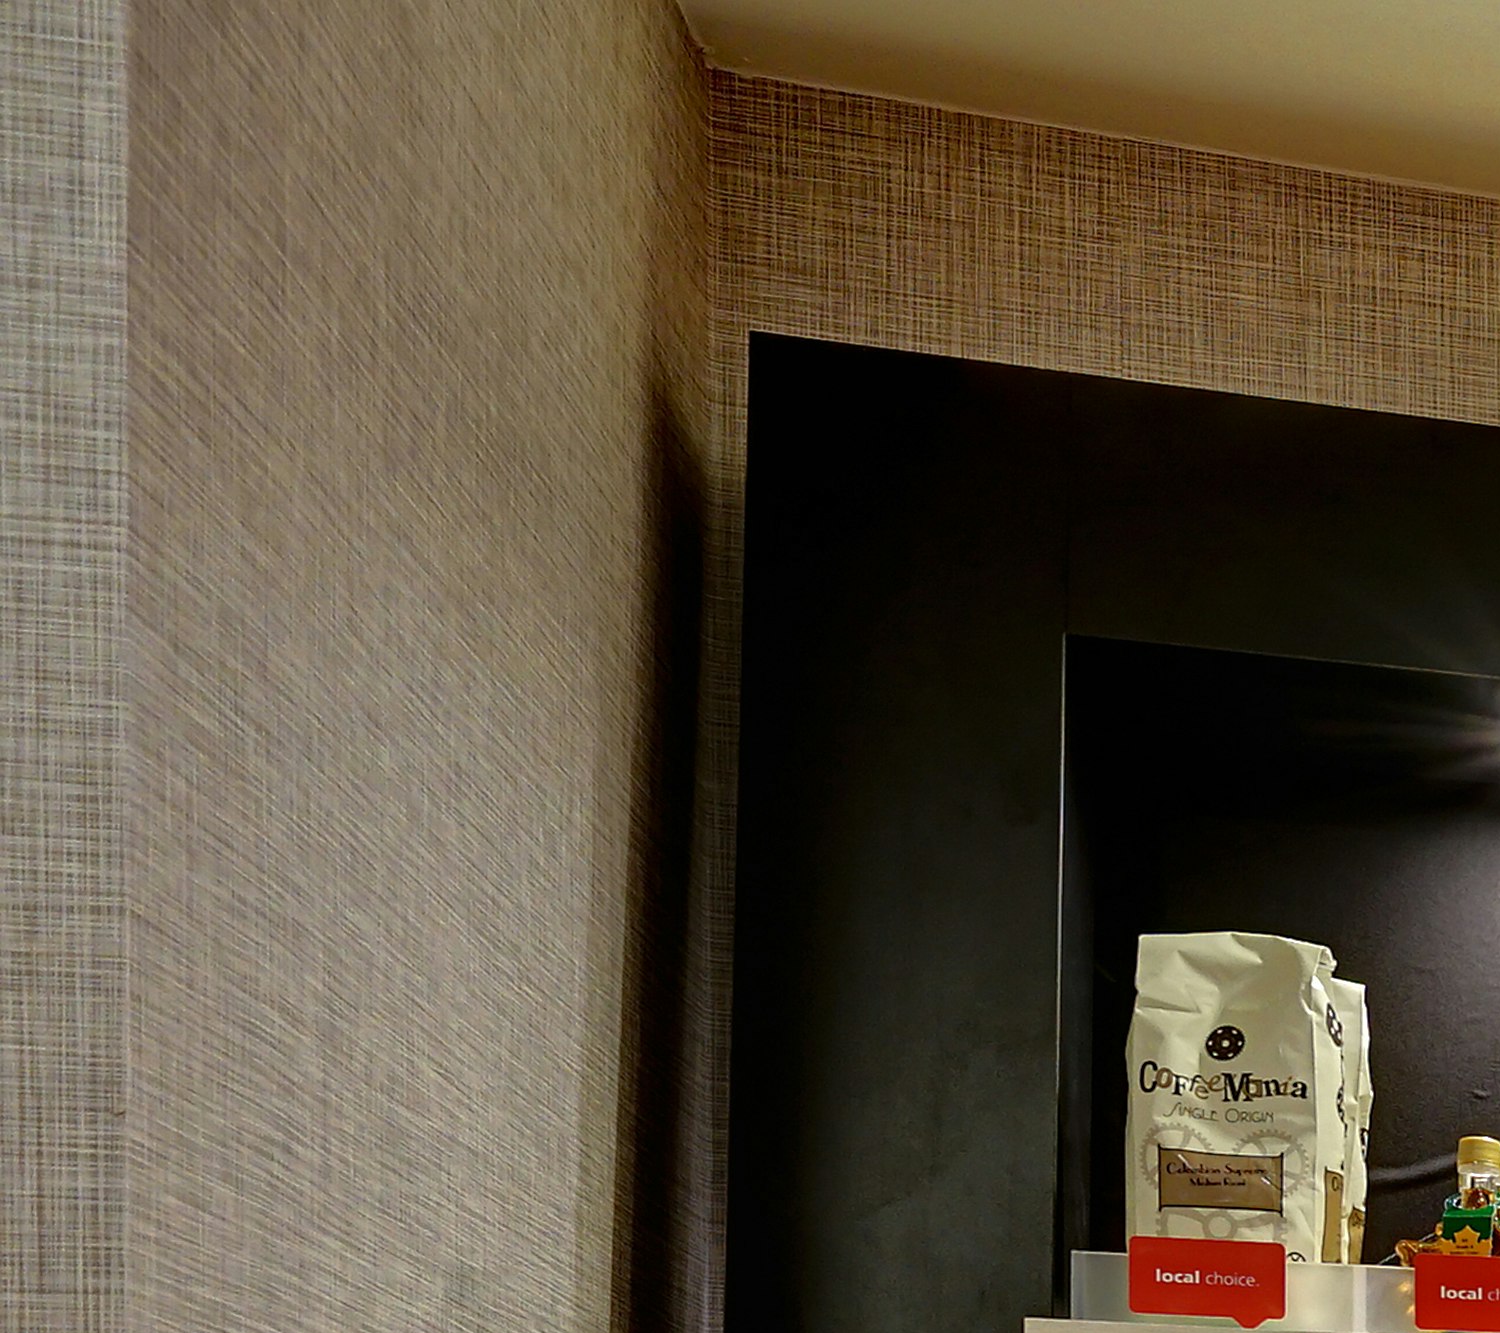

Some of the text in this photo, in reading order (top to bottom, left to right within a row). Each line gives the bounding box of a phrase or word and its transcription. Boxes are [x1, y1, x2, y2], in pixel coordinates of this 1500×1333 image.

[1155, 1268, 1260, 1287] local choice.
[1440, 1284, 1483, 1302] local
